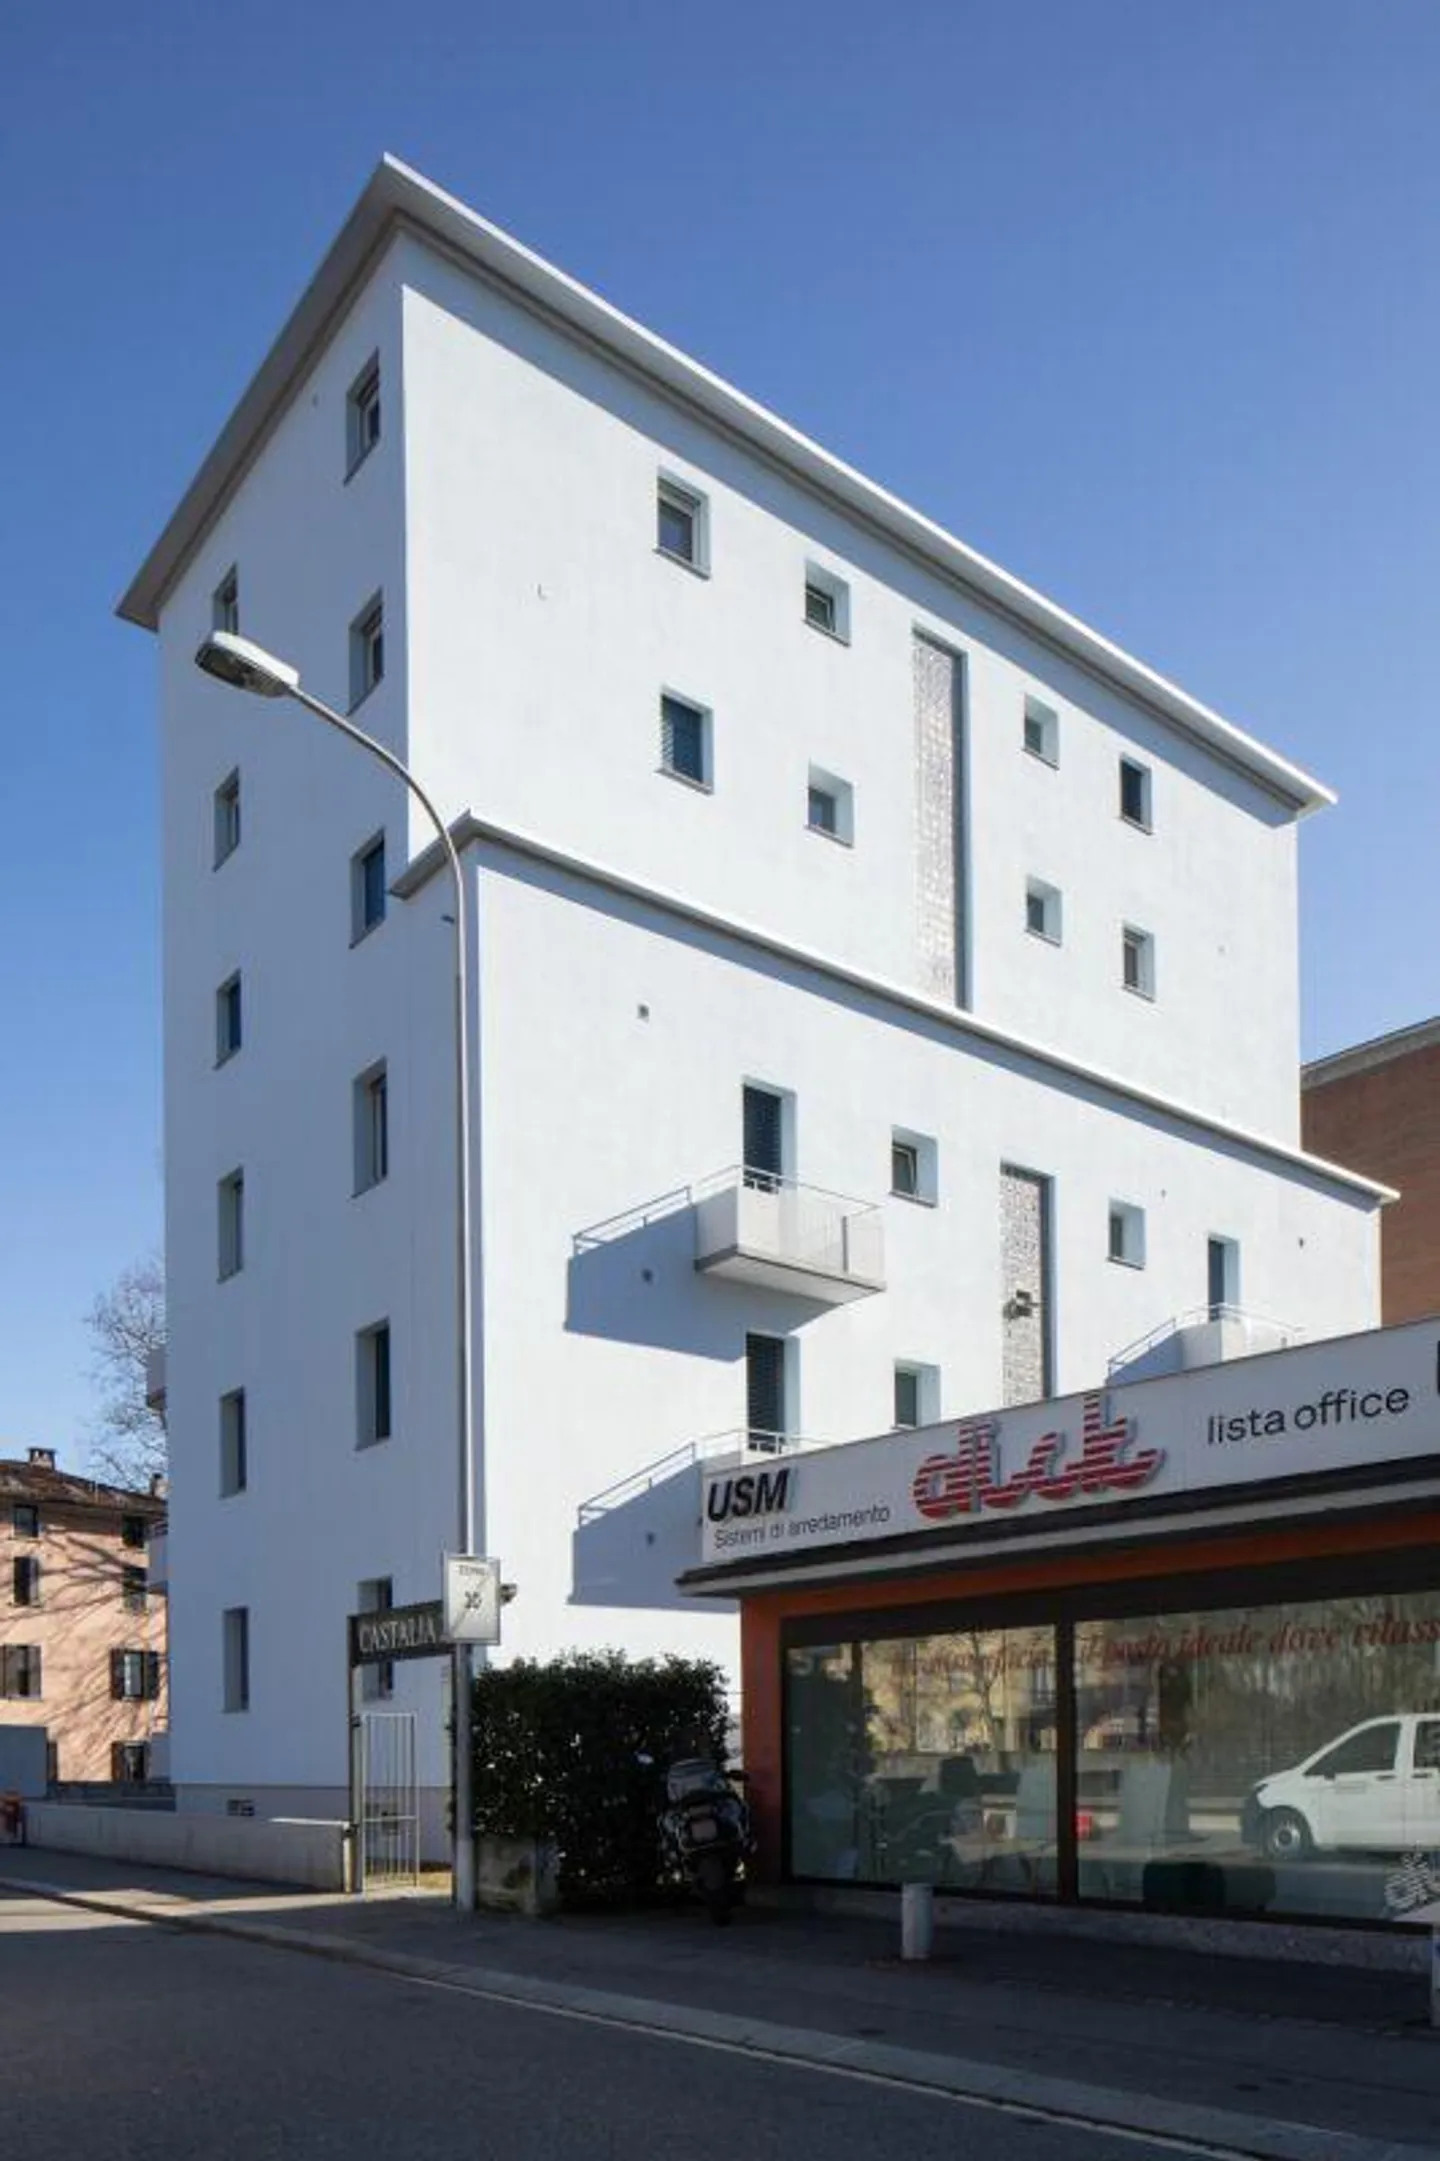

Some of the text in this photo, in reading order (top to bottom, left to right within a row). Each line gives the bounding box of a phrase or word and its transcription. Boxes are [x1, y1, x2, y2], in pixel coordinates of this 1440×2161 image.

[1207, 1387, 1410, 1445] lista office
[707, 1467, 791, 1523] USM
[714, 1503, 892, 1549] Sistemi di arredamento
[359, 1615, 437, 1654] CASTALIA
[1268, 1620, 1341, 1654] dove
